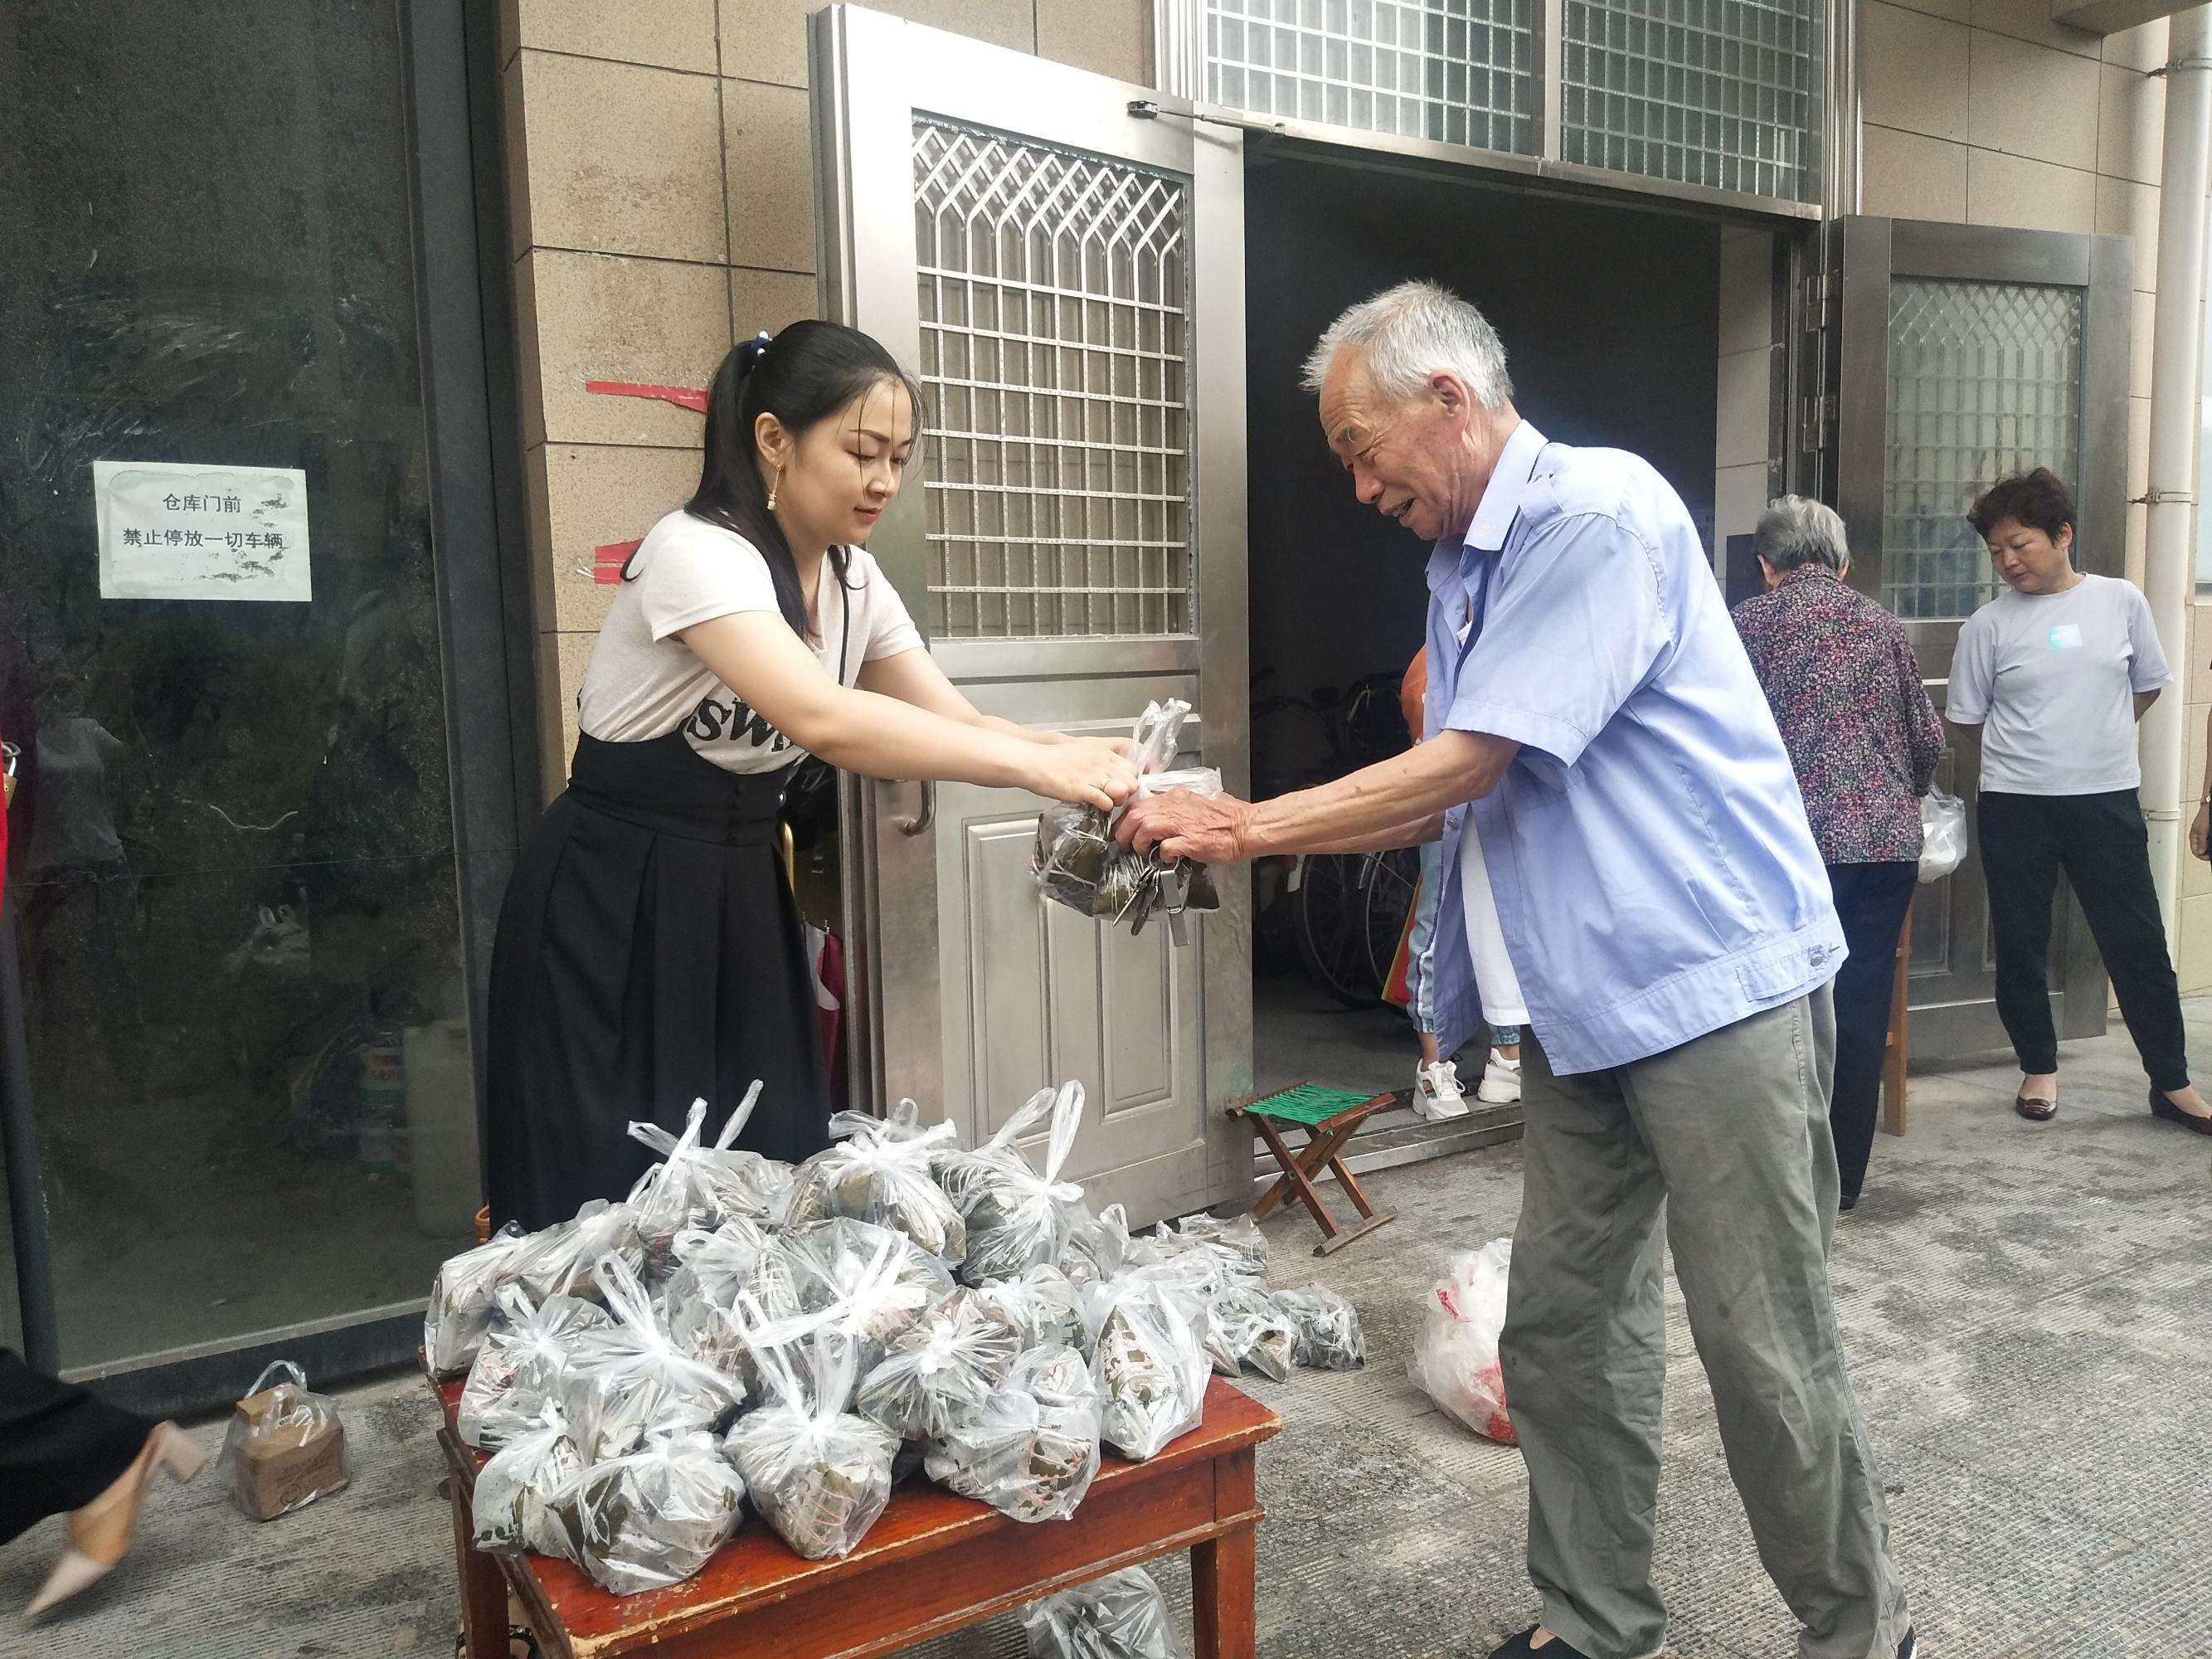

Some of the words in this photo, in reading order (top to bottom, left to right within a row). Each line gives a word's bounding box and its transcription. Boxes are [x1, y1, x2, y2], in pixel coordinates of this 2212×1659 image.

[163, 493, 242, 513] 仓库门前
[123, 528, 284, 549] 禁止停放一切车辆
